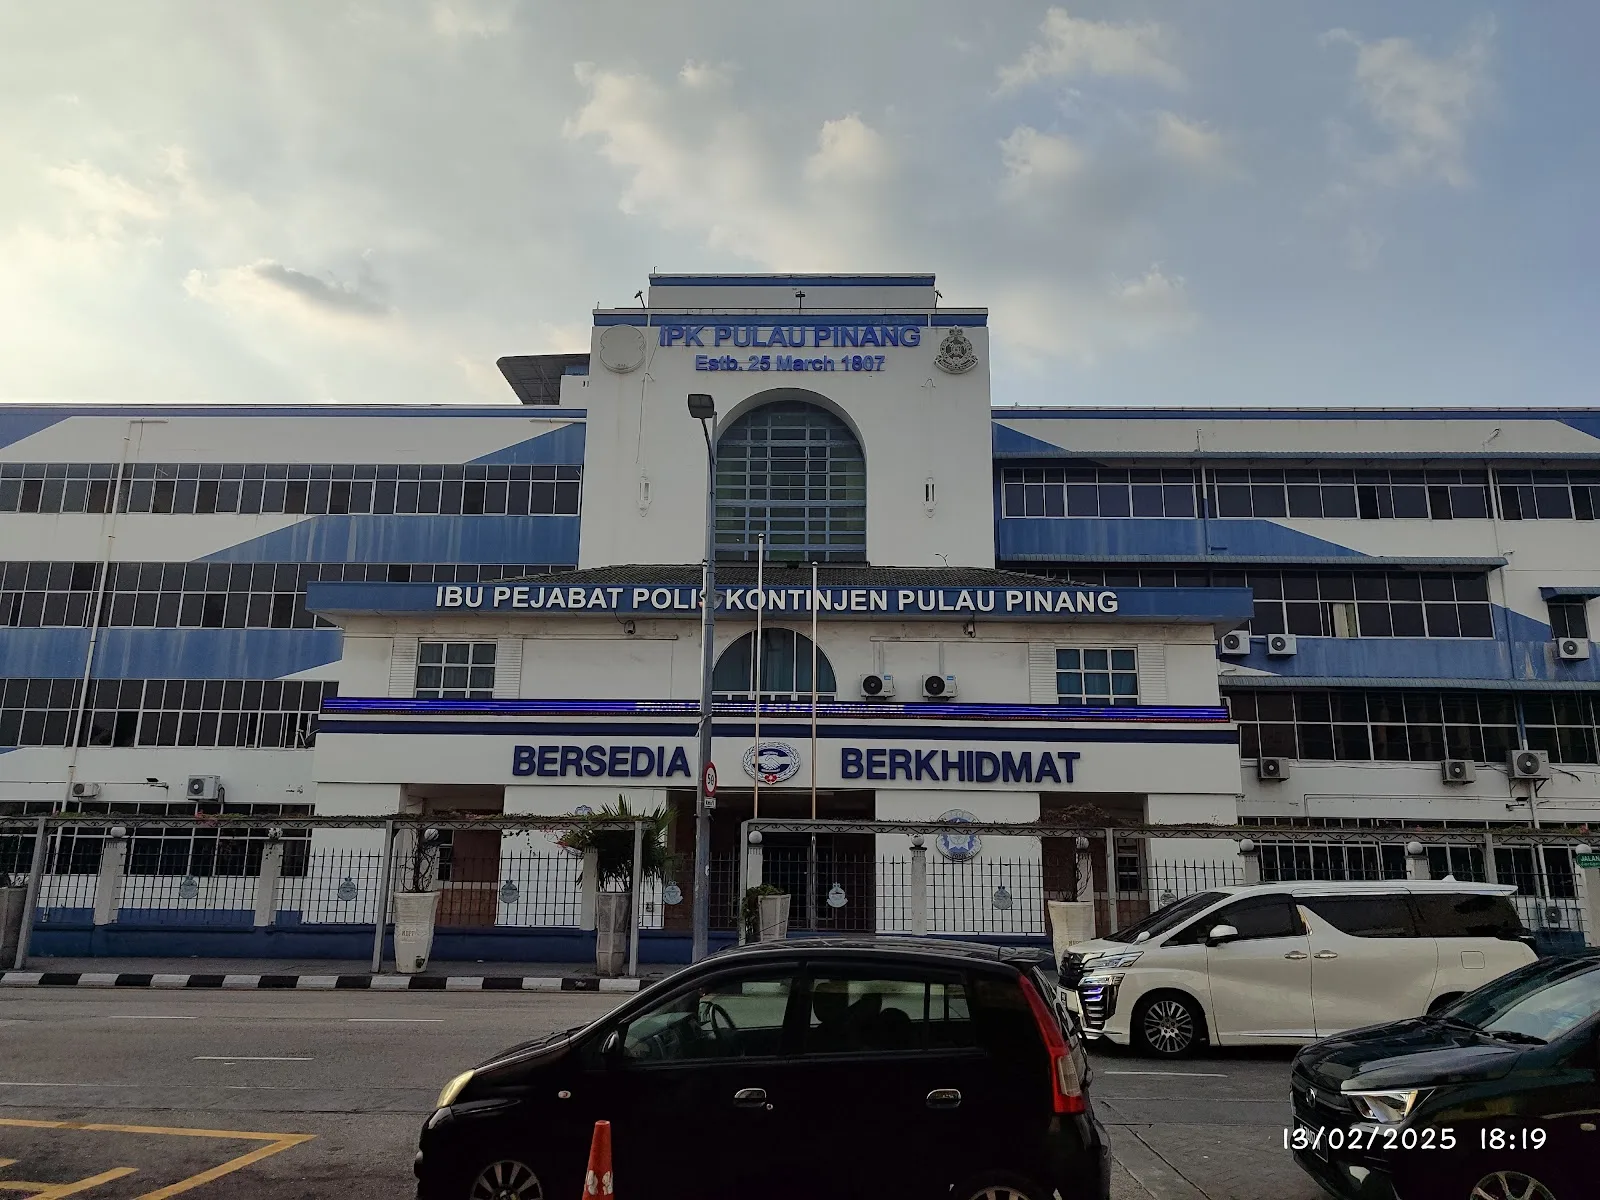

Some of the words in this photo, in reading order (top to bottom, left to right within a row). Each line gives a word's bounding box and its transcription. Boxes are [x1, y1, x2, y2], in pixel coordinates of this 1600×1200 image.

[659, 325, 704, 347] IPK
[714, 325, 805, 347] PULAU
[814, 326, 921, 347] PINANG
[695, 355, 743, 371] Estb.
[748, 355, 771, 371] 25
[776, 355, 836, 371] March
[841, 355, 885, 371] 1807
[436, 586, 483, 607] IBU
[493, 586, 624, 609] PEJABAT
[726, 588, 887, 611] KONTINJEN
[898, 590, 995, 612] PULAU
[1006, 591, 1119, 613] PINANG
[512, 745, 691, 777] BERSEDIA
[841, 748, 1081, 783] BERKHIDMAT
[707, 773, 715, 785] 50
